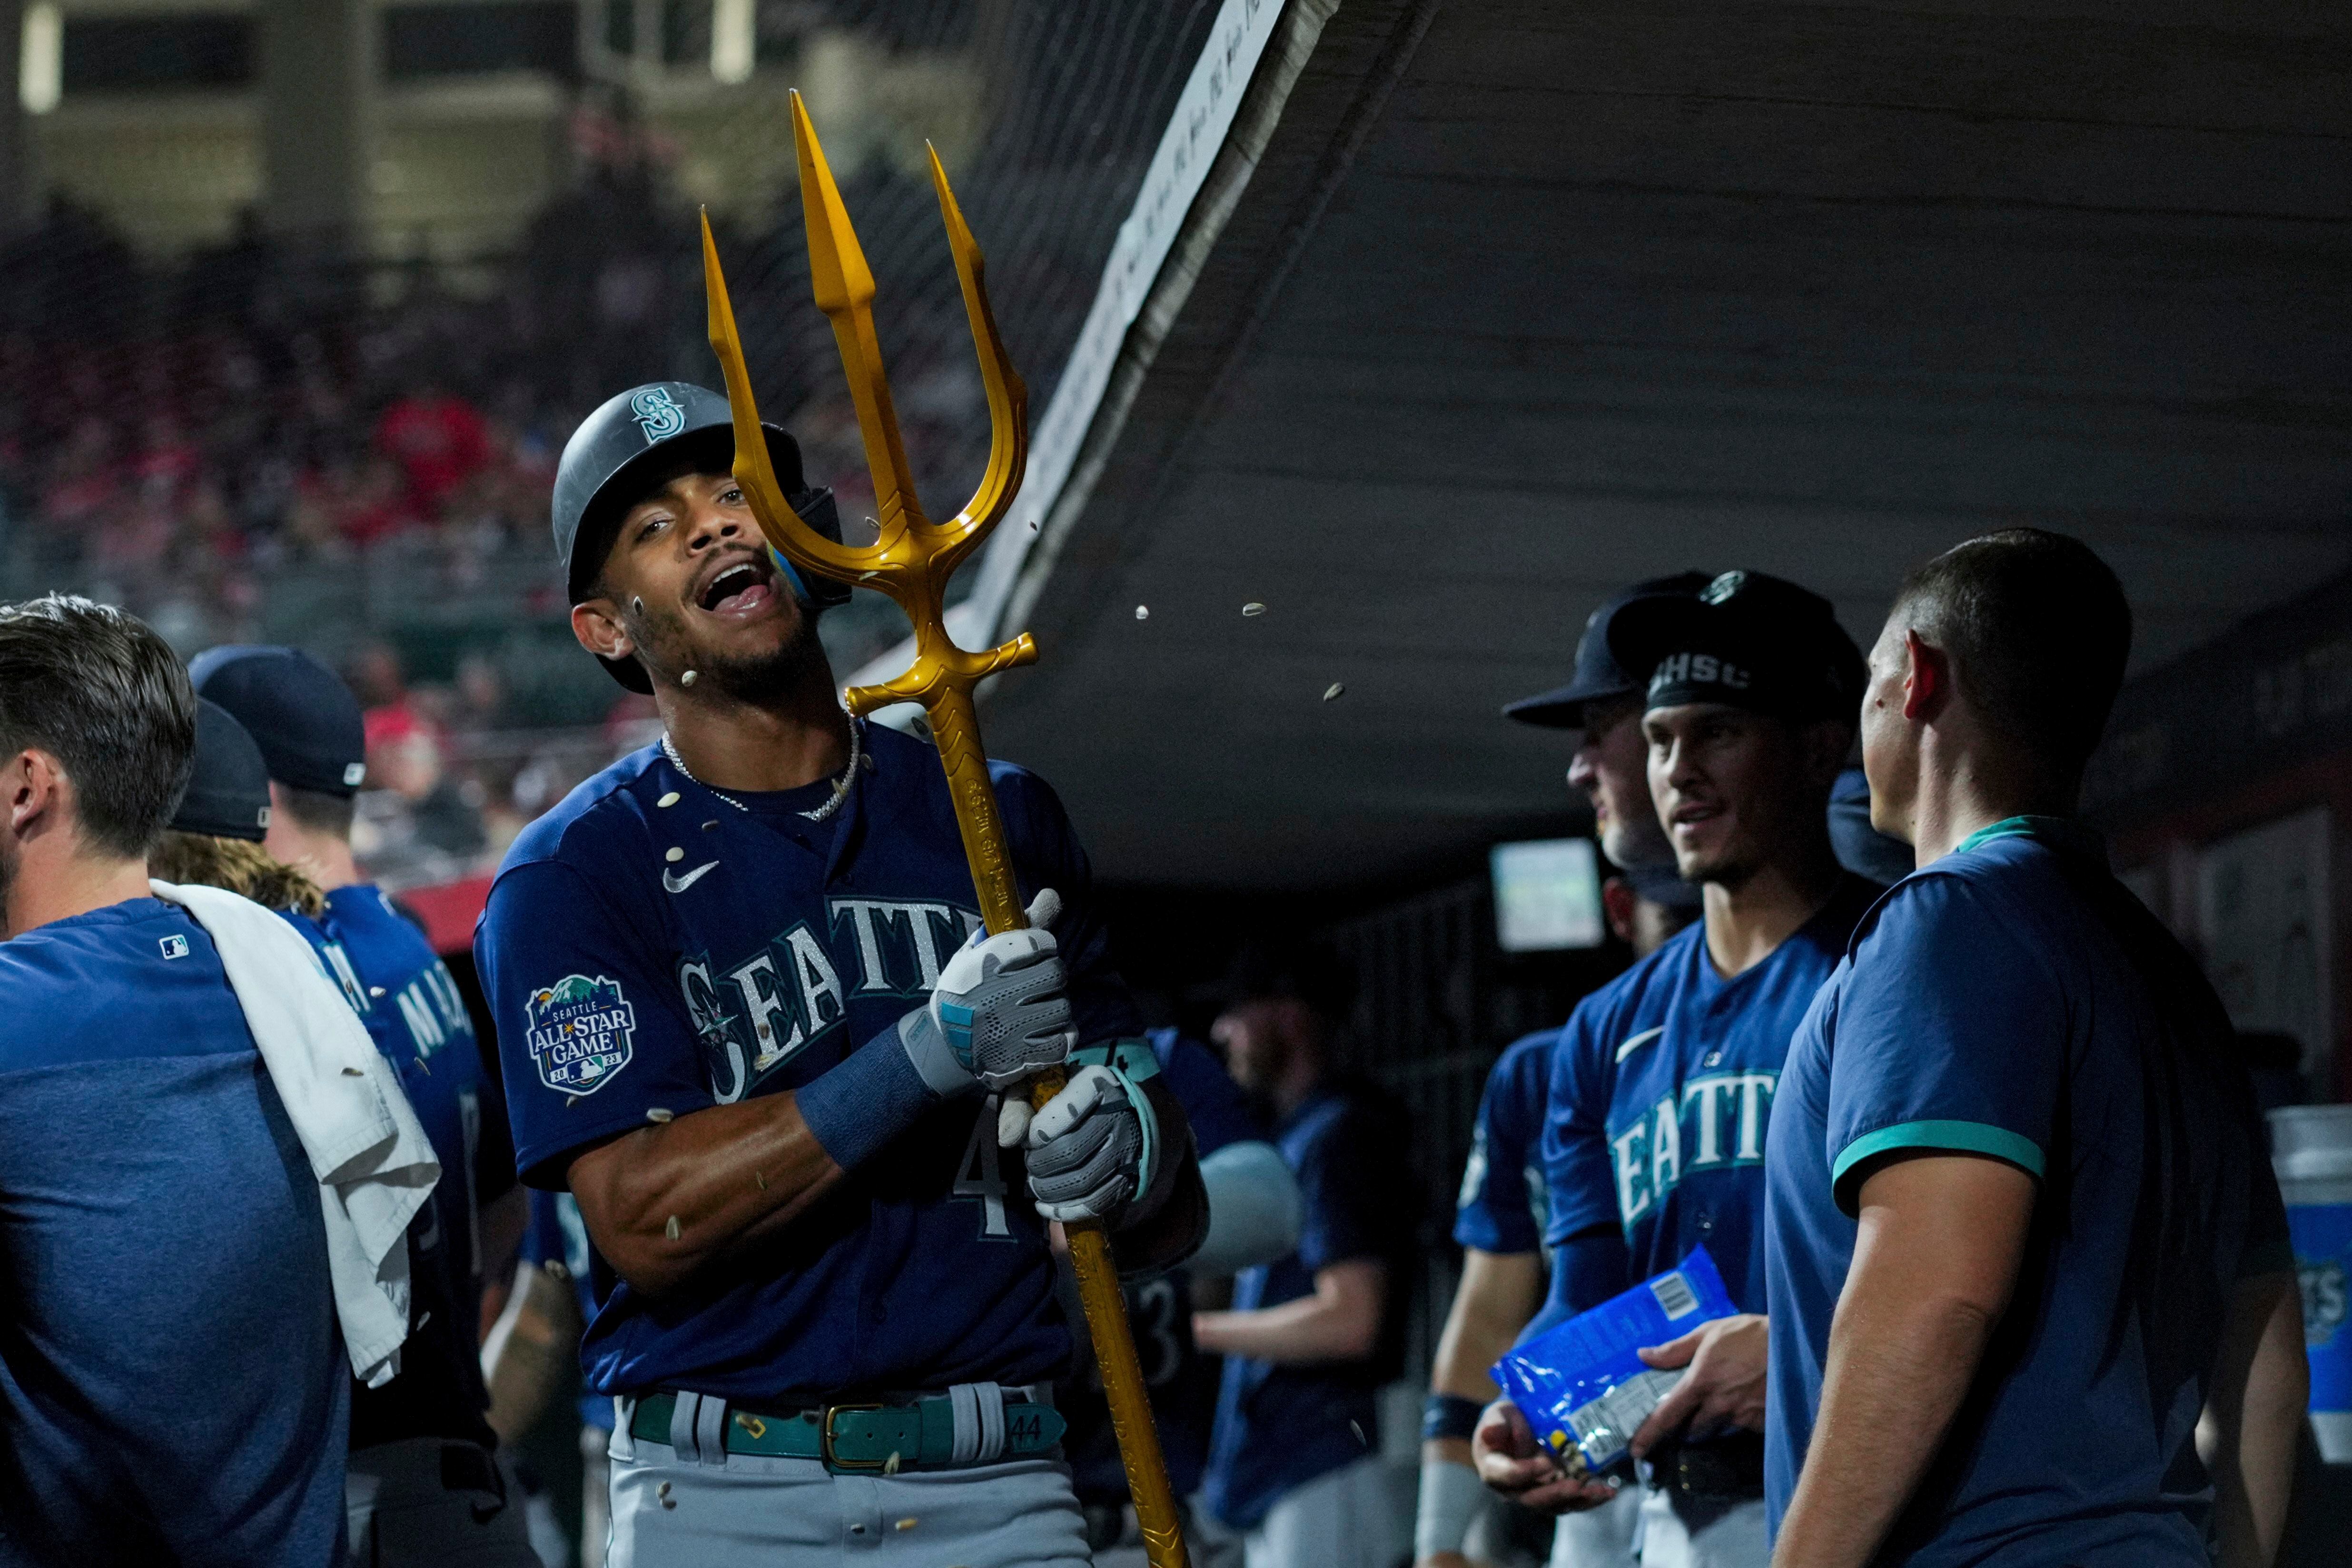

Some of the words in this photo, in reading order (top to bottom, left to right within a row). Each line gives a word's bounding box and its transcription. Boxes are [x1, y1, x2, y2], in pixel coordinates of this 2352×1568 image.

[631, 386, 685, 445] S
[553, 1001, 597, 1022] SEATTLE
[678, 897, 981, 1105] SEATT
[535, 1023, 572, 1053] ALL
[573, 1010, 630, 1037] STAR
[553, 1032, 613, 1064] GAME
[554, 1070, 564, 1080] 20
[606, 1055, 617, 1064] 23
[952, 1094, 1009, 1235] 4
[1610, 1071, 1776, 1224] EATT
[1139, 1278, 1182, 1388] 3
[1009, 1413, 1042, 1441] 44
